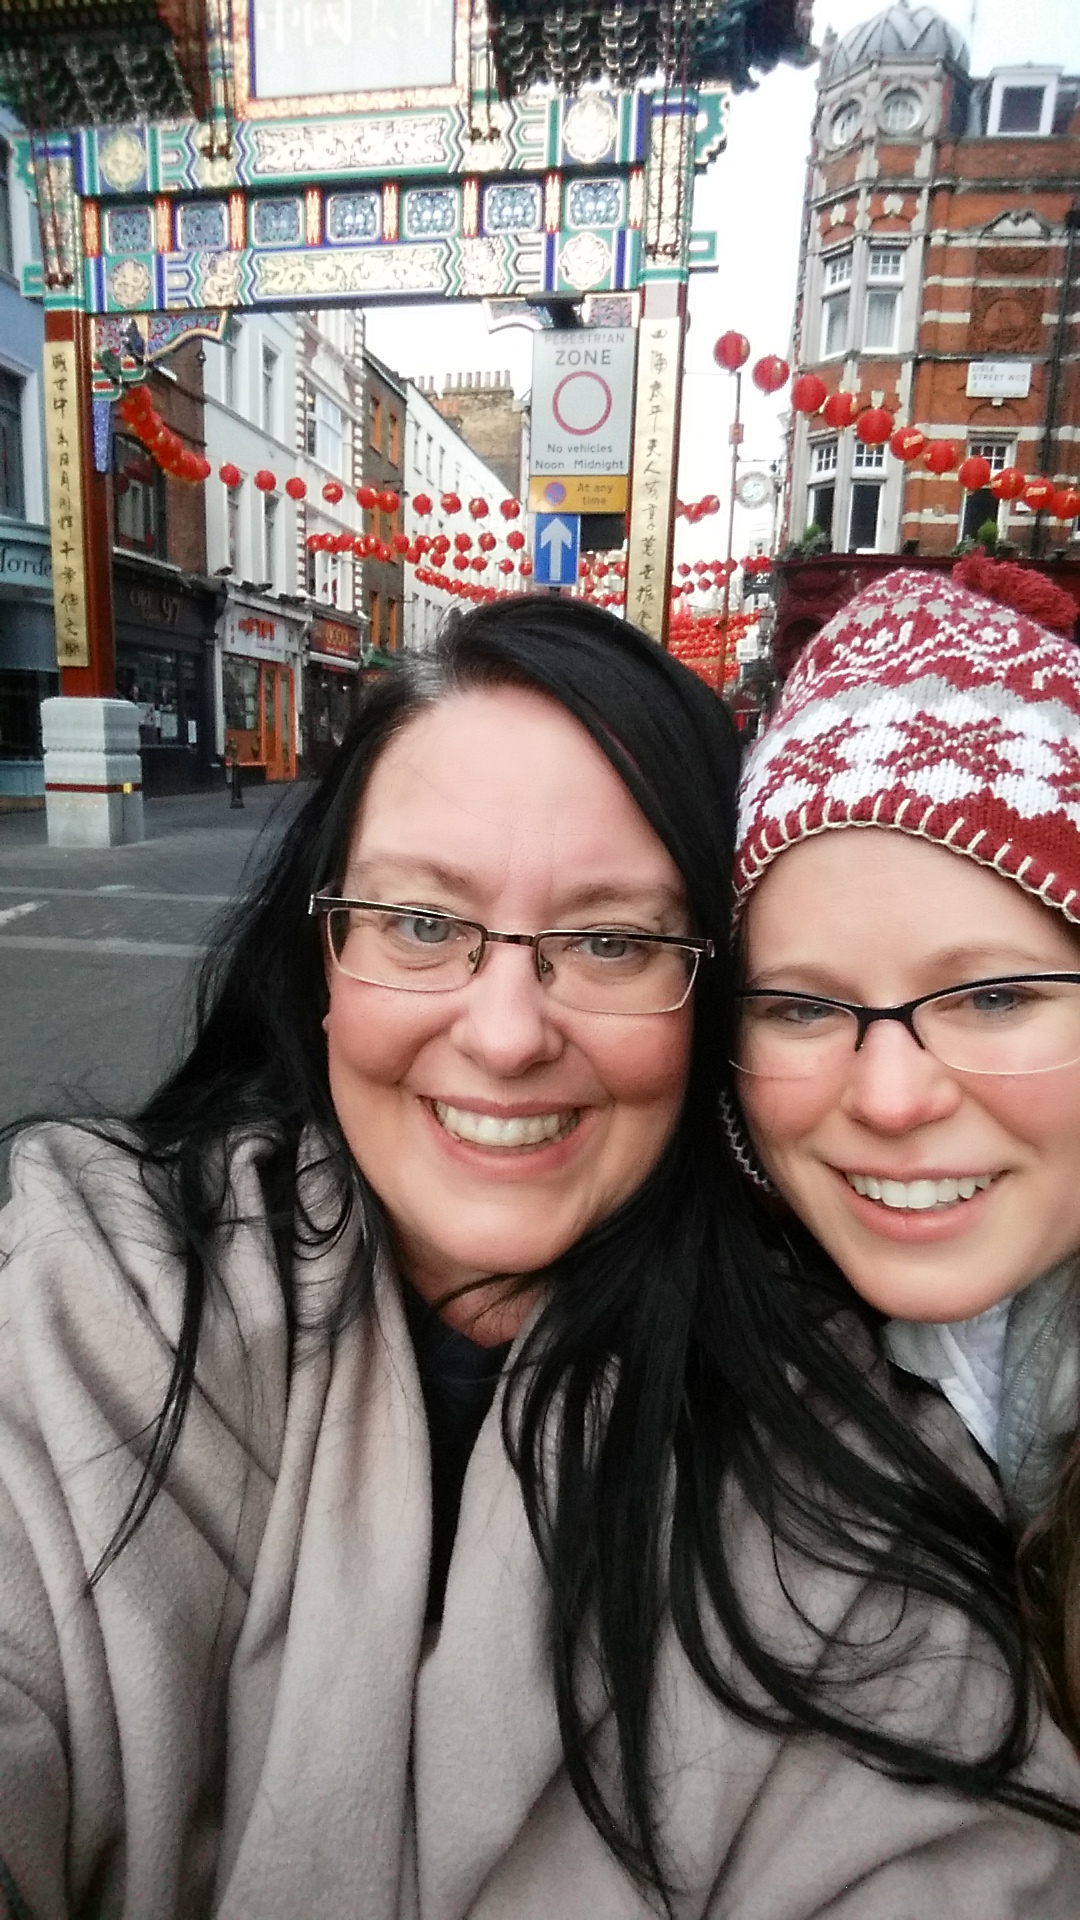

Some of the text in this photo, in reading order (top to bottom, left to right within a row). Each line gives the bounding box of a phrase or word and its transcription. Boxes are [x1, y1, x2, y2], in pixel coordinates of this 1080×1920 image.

[544, 332, 625, 345] PEDESTRIAN
[555, 348, 611, 366] ZONE
[972, 373, 1004, 381] STREET
[547, 443, 613, 453] No vehicles
[535, 459, 624, 471] Noon Midnight
[577, 483, 614, 494] At any
[582, 496, 607, 505] time
